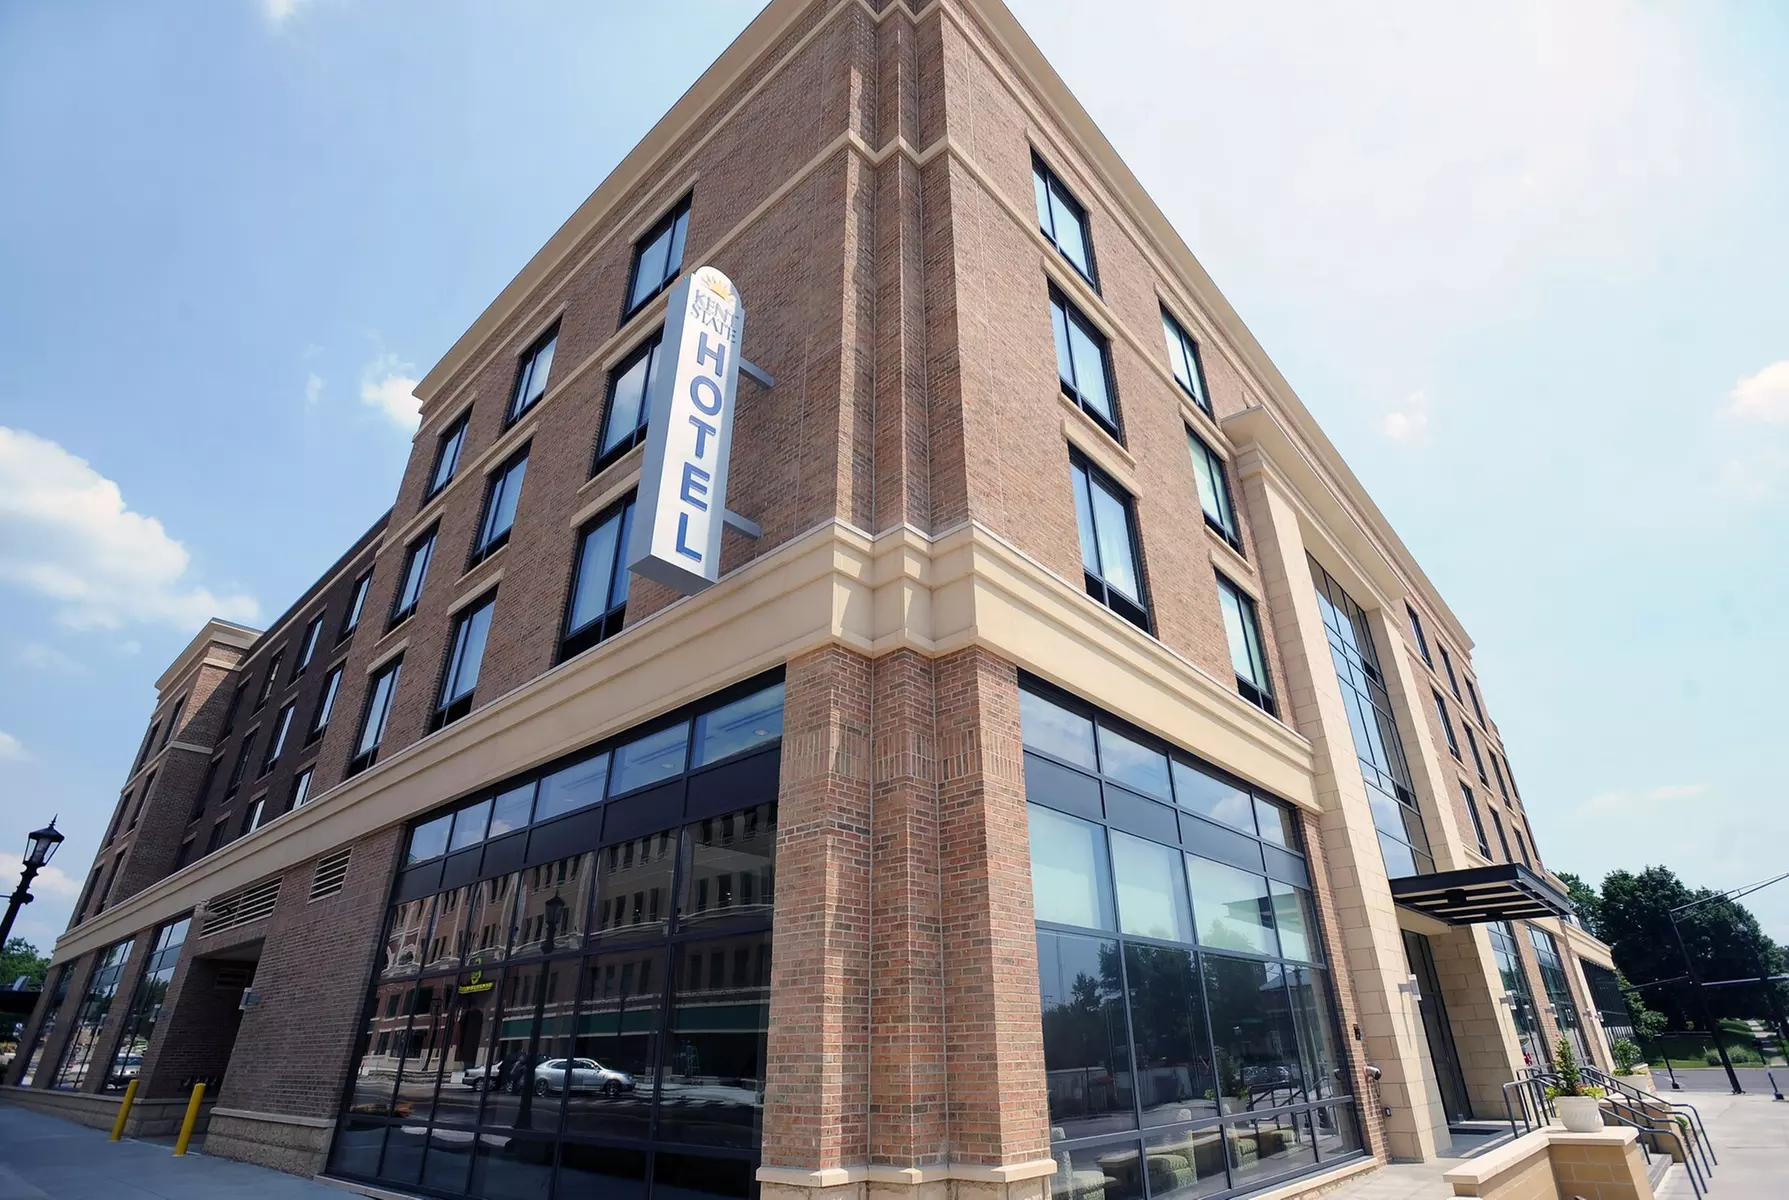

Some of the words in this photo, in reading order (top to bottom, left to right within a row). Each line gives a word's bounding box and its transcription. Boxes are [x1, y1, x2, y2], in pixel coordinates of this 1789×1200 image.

[690, 303, 737, 344] STATE
[695, 289, 739, 326] KENT
[675, 331, 725, 562] HOTEL
